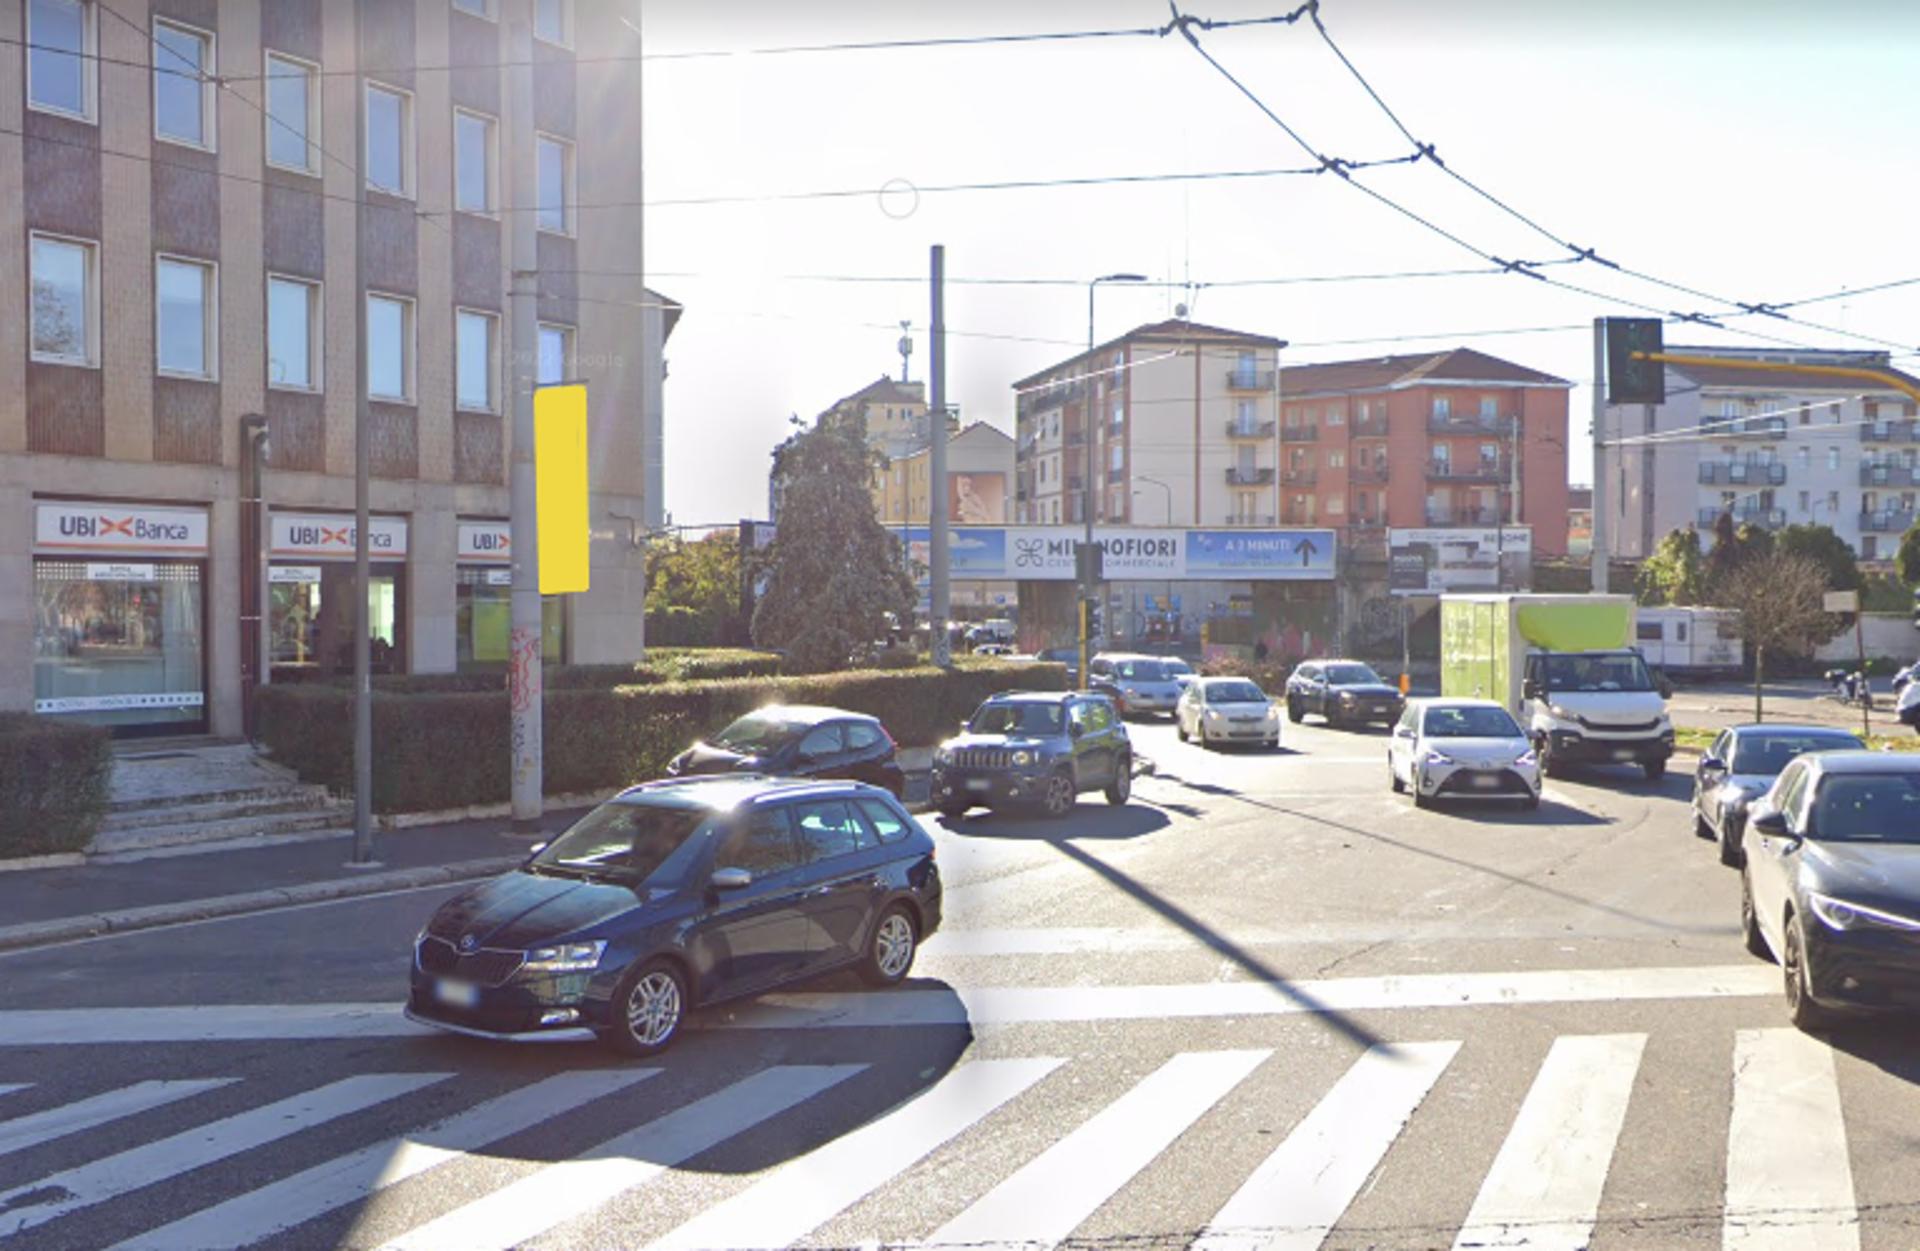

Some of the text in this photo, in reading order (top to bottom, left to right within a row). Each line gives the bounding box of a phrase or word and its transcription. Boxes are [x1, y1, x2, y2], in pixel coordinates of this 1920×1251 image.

[59, 515, 188, 540] UBI Banca
[289, 526, 392, 548] UBI Bnca
[473, 533, 498, 550] UBI
[1047, 538, 1177, 556] MILNOFIORI
